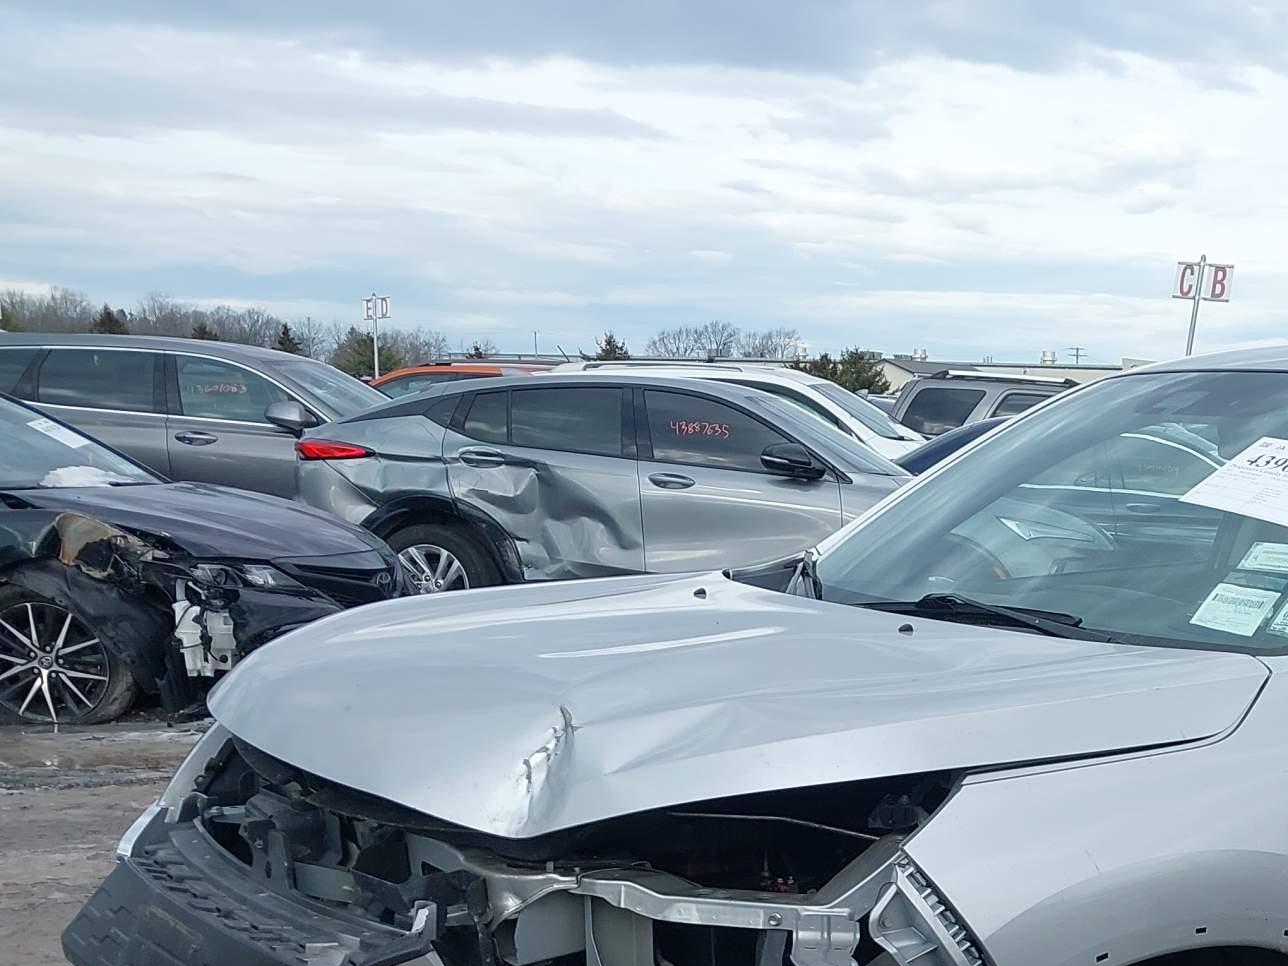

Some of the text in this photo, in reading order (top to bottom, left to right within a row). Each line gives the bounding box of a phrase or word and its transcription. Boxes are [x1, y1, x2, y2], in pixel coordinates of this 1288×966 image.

[1180, 264, 1227, 298] C B
[366, 298, 388, 319] E D
